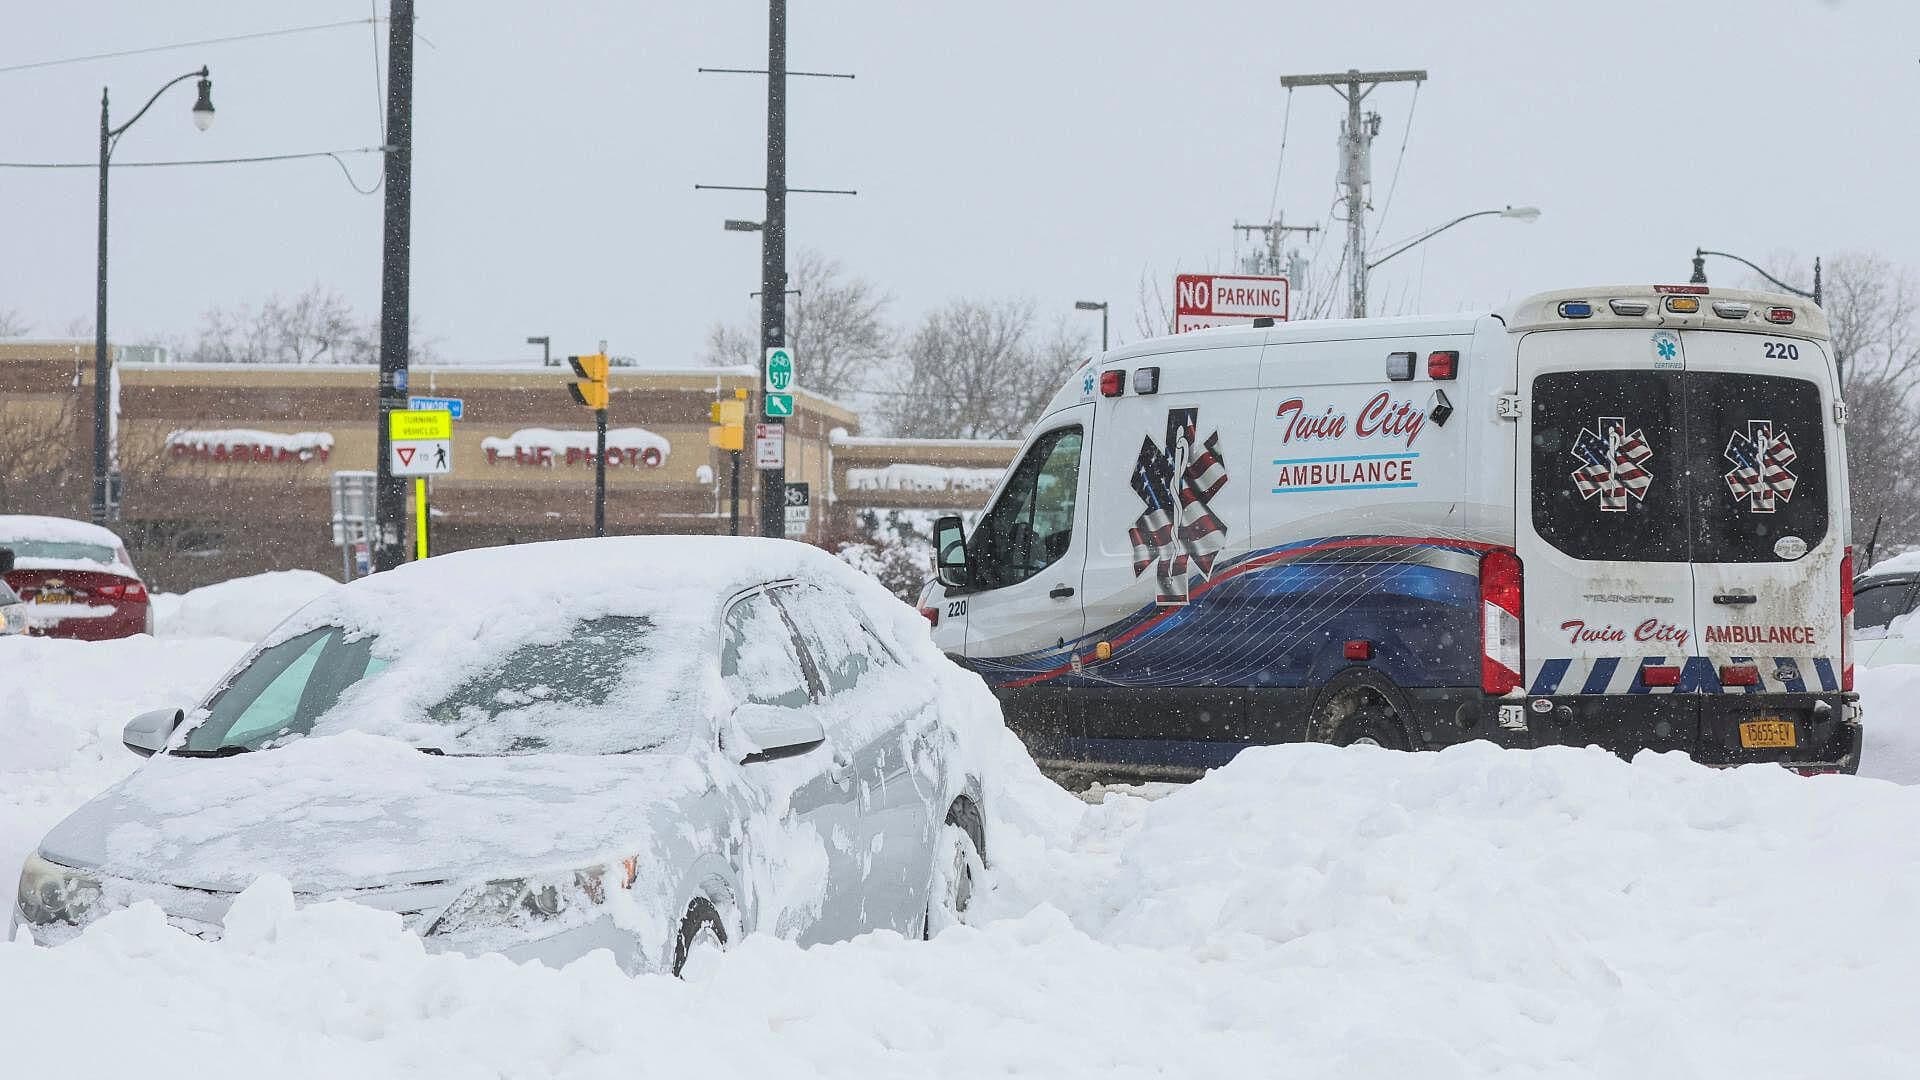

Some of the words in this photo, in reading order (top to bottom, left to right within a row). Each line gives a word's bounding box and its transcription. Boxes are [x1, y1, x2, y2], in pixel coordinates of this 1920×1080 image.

[1180, 281, 1209, 309] NO
[1217, 287, 1280, 307] PARKING
[1764, 341, 1799, 360] 220
[773, 371, 789, 386] 517
[404, 415, 438, 424] TURNING
[1276, 399, 1347, 444] Twin
[1355, 391, 1425, 449] City
[403, 427, 440, 436] VEHICLES
[1279, 460, 1412, 486] AMBULANCE
[948, 600, 966, 618] 220
[1561, 620, 1625, 644] Twin
[1634, 618, 1690, 647] City
[1705, 625, 1815, 644] AMBULANCE
